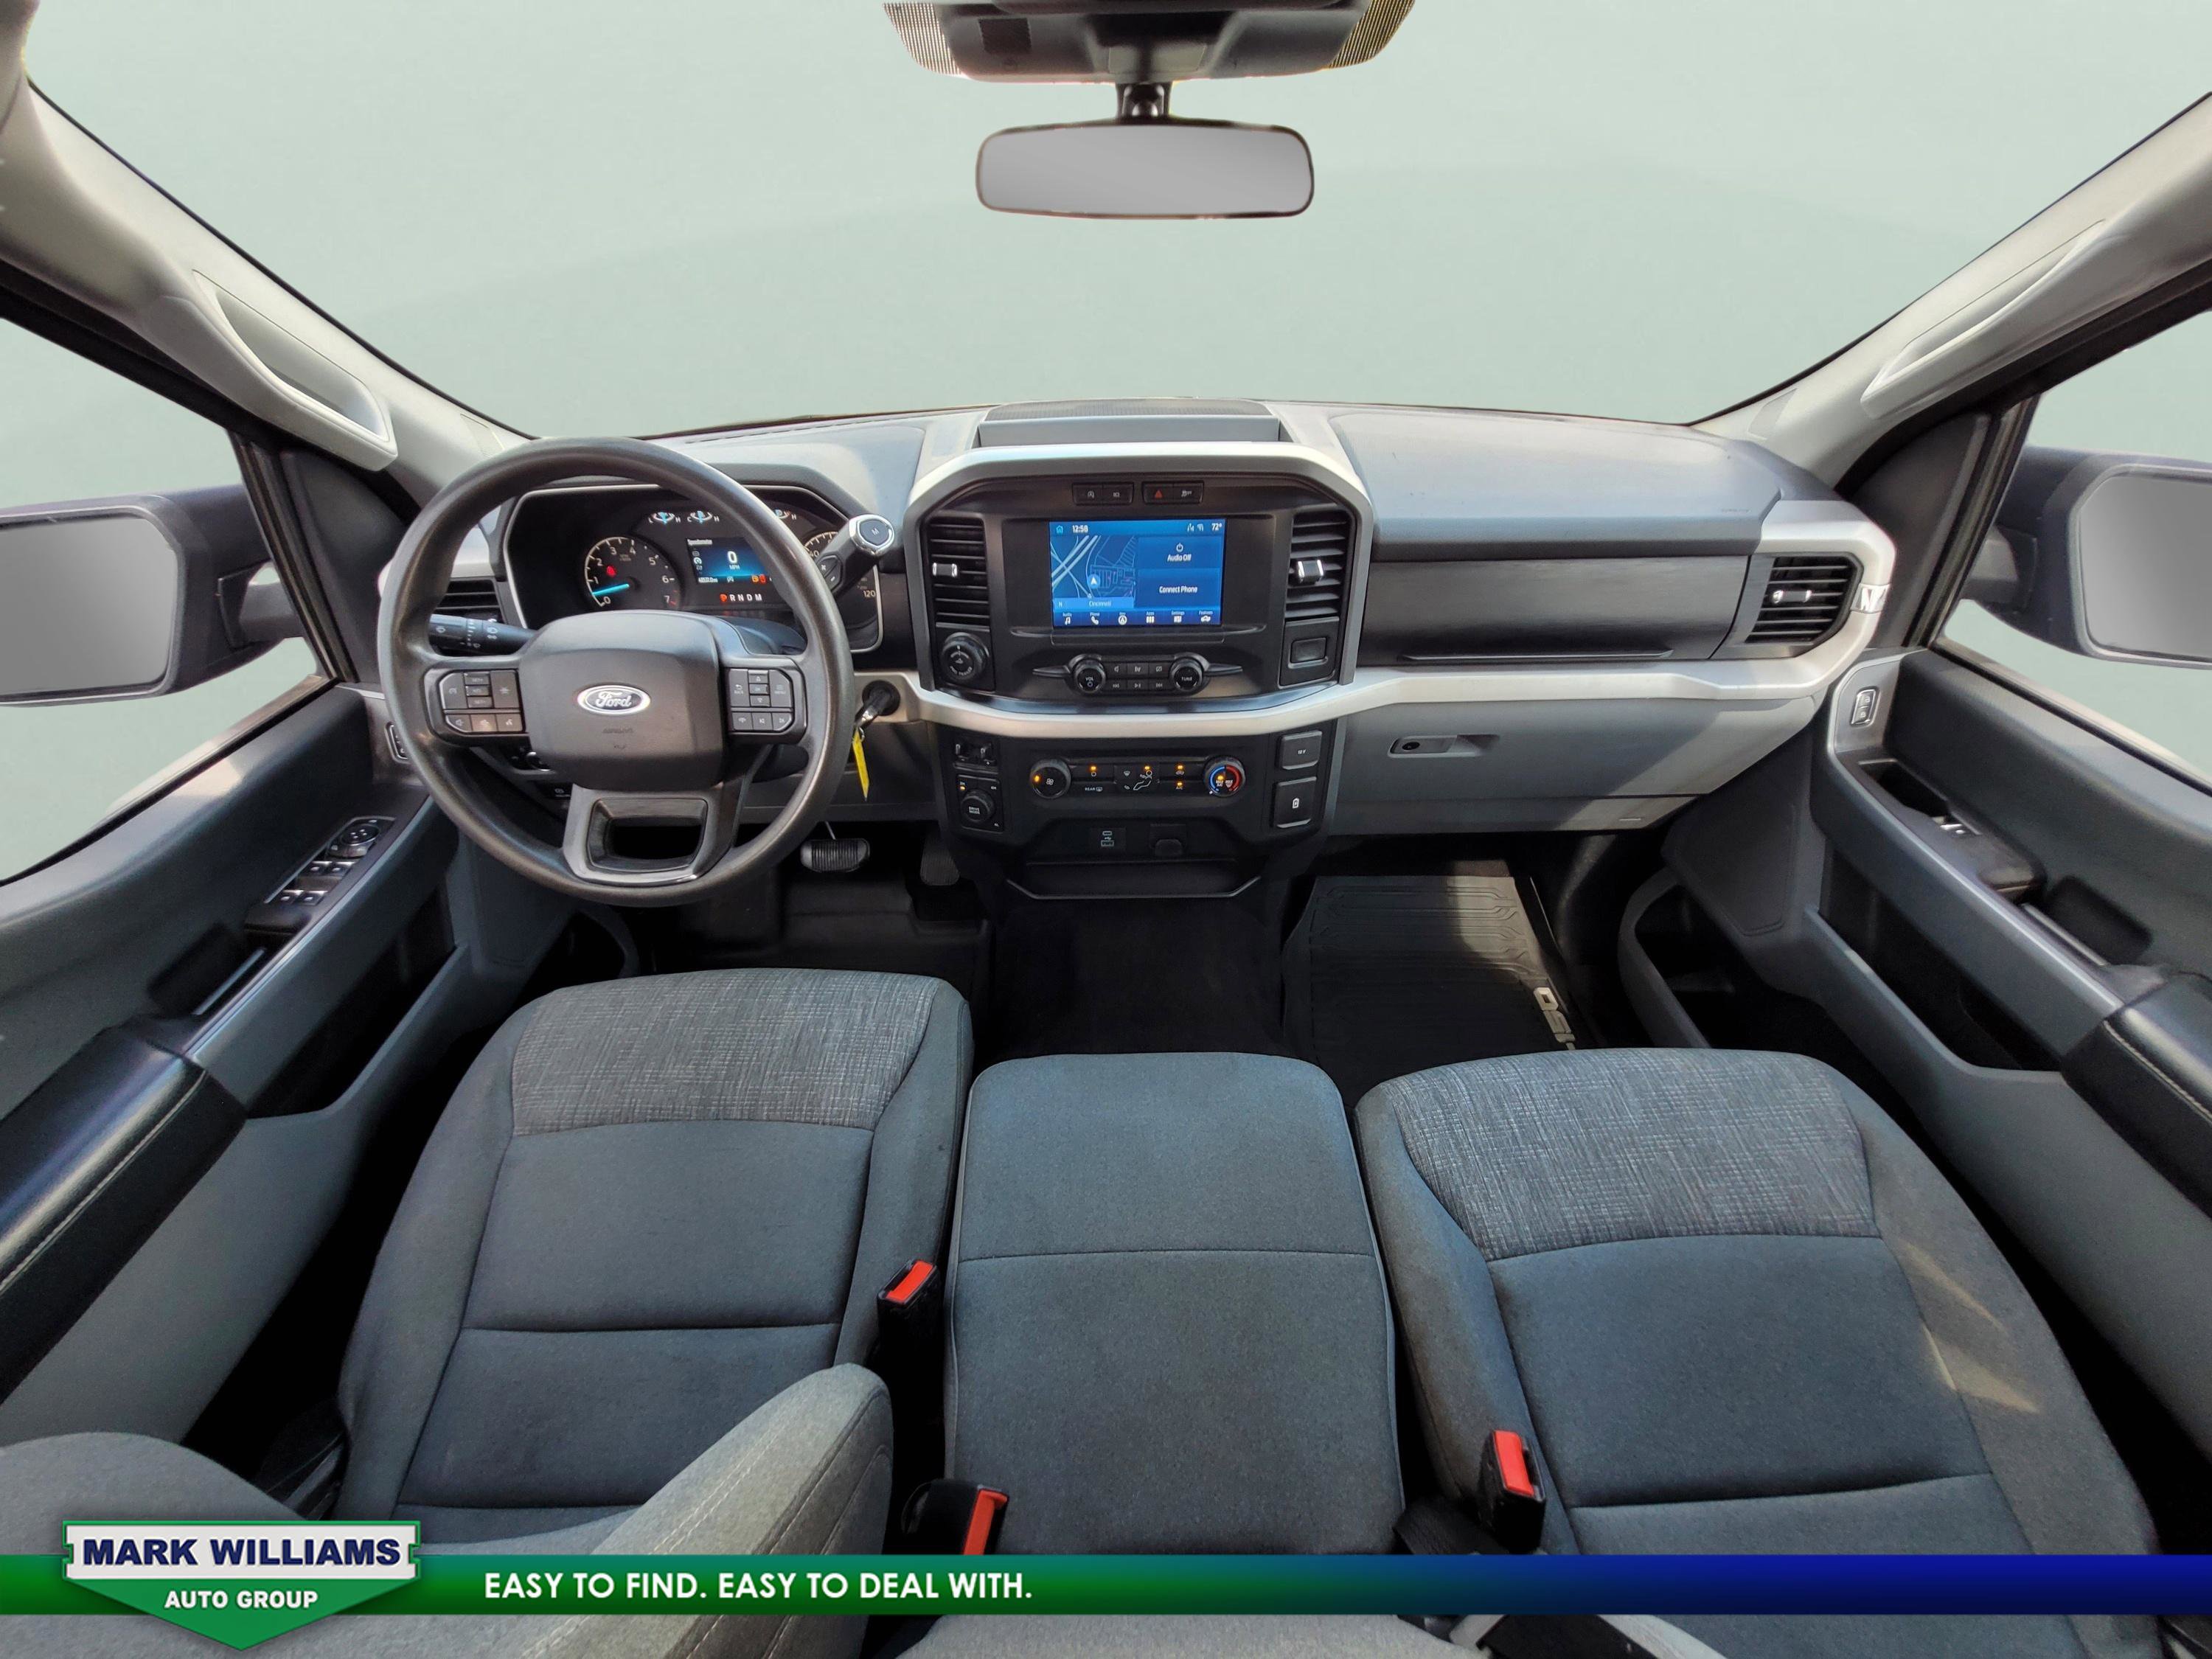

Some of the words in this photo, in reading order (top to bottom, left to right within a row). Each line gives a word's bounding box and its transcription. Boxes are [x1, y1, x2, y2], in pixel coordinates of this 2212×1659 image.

[610, 546, 617, 555] 3
[629, 547, 636, 555] 4
[596, 558, 604, 566] 2
[649, 557, 656, 566] 5
[727, 551, 738, 564] 0
[593, 576, 599, 585] 1
[661, 575, 669, 583] 6
[720, 594, 728, 602] P
[738, 594, 745, 602] N
[747, 594, 753, 602] D
[755, 594, 762, 602] M
[863, 590, 876, 598] 120
[603, 596, 611, 605] 0
[664, 595, 670, 604] 7
[595, 691, 632, 708] Ford
